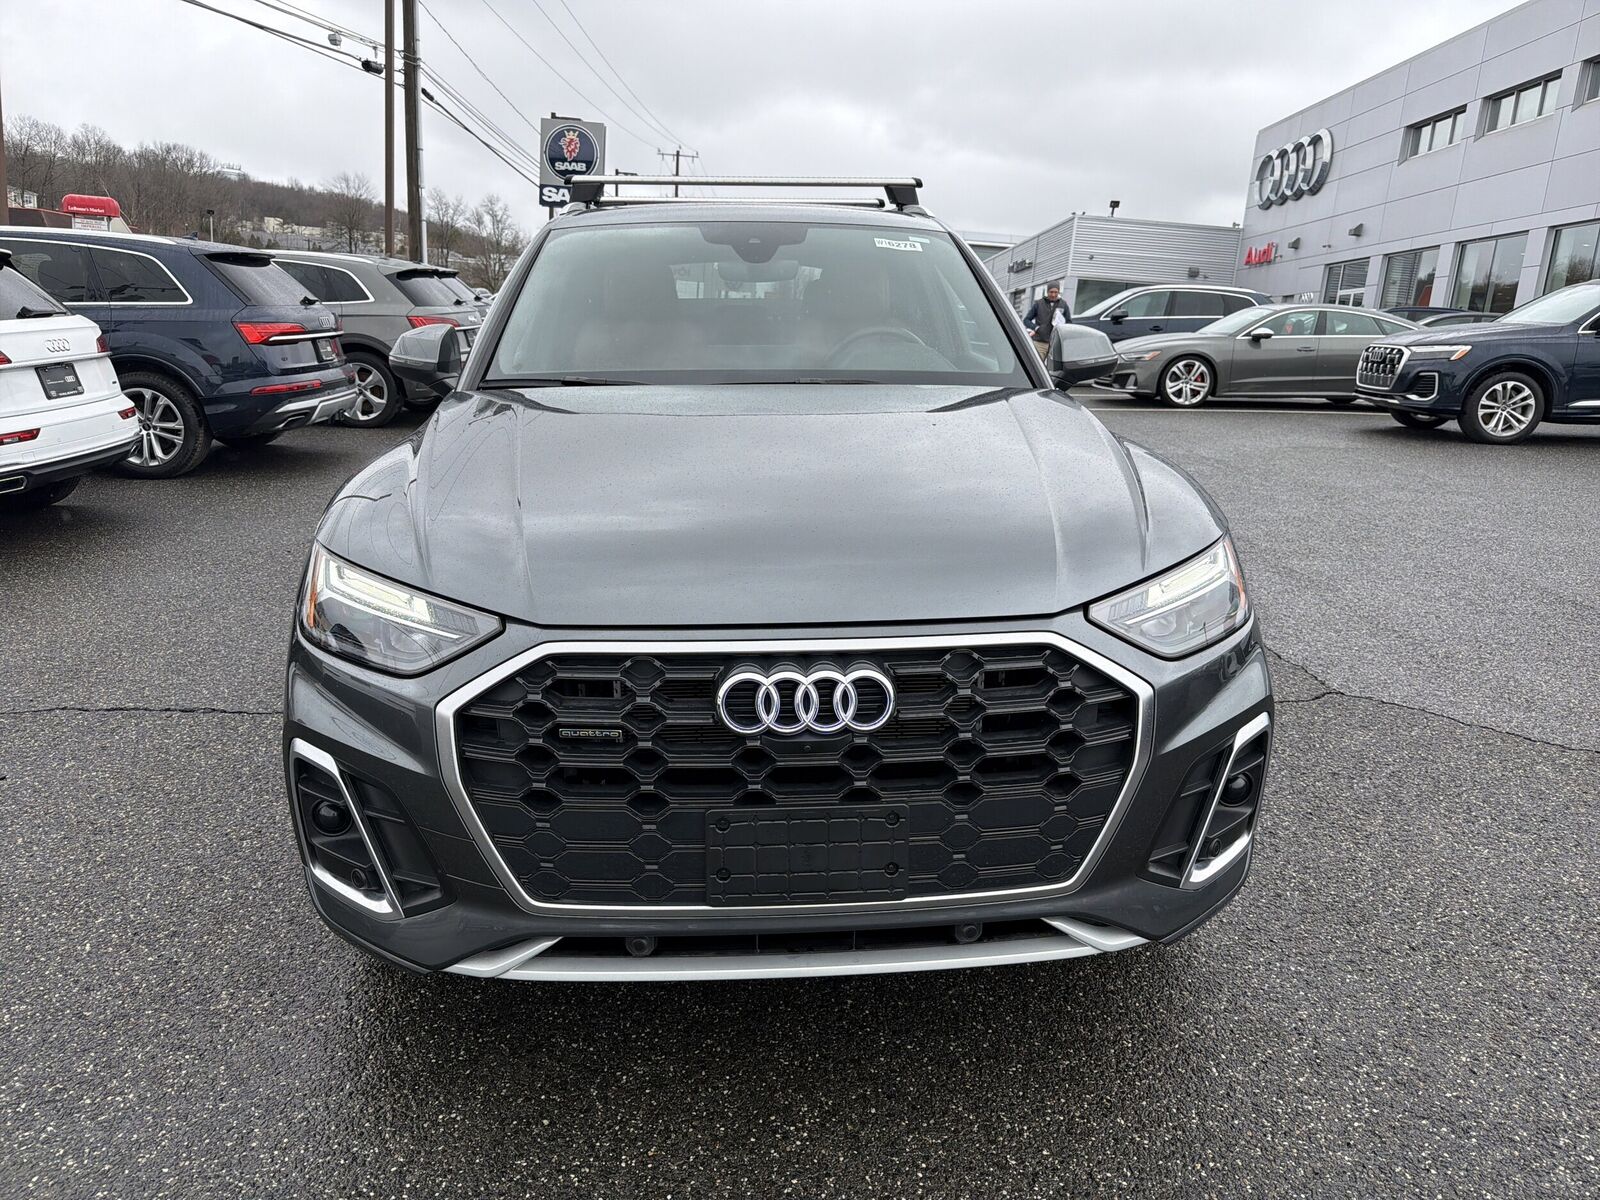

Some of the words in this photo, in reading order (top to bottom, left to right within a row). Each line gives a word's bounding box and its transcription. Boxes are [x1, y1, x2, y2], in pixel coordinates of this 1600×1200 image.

[554, 161, 586, 171] SAAB
[541, 186, 571, 203] SA
[1243, 241, 1276, 266] Audi
[561, 730, 619, 738] quattro
